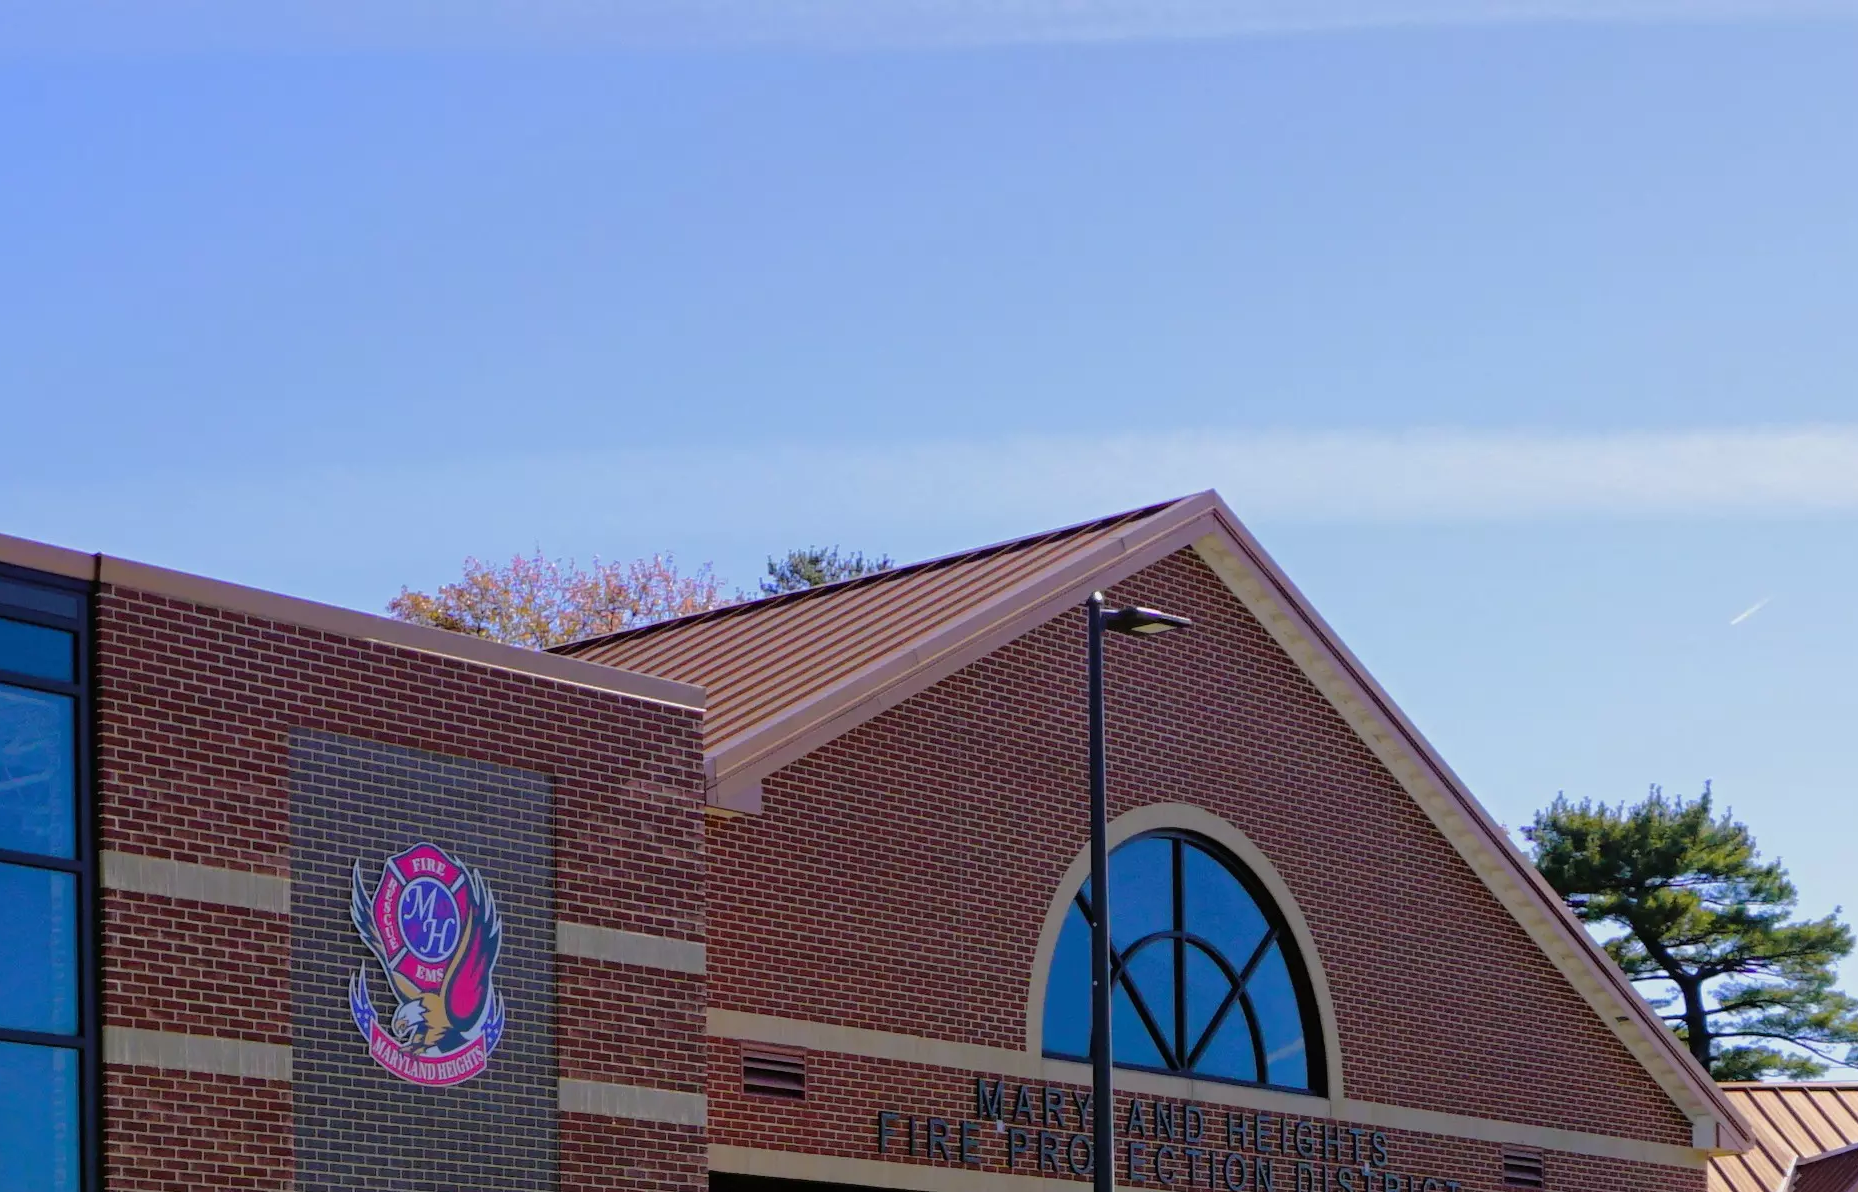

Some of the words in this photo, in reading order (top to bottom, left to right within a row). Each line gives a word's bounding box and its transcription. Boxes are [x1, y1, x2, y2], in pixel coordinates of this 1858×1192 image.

[411, 856, 447, 877] FIRE
[384, 876, 398, 951] RESCUE
[415, 965, 445, 983] EMS
[372, 1034, 437, 1081] MARYLAND
[437, 1045, 486, 1081] HEIGHTS
[877, 1110, 981, 1165] FIRE
[976, 1077, 1205, 1145] MARYAND
[1226, 1111, 1390, 1168] HEIGHTS
